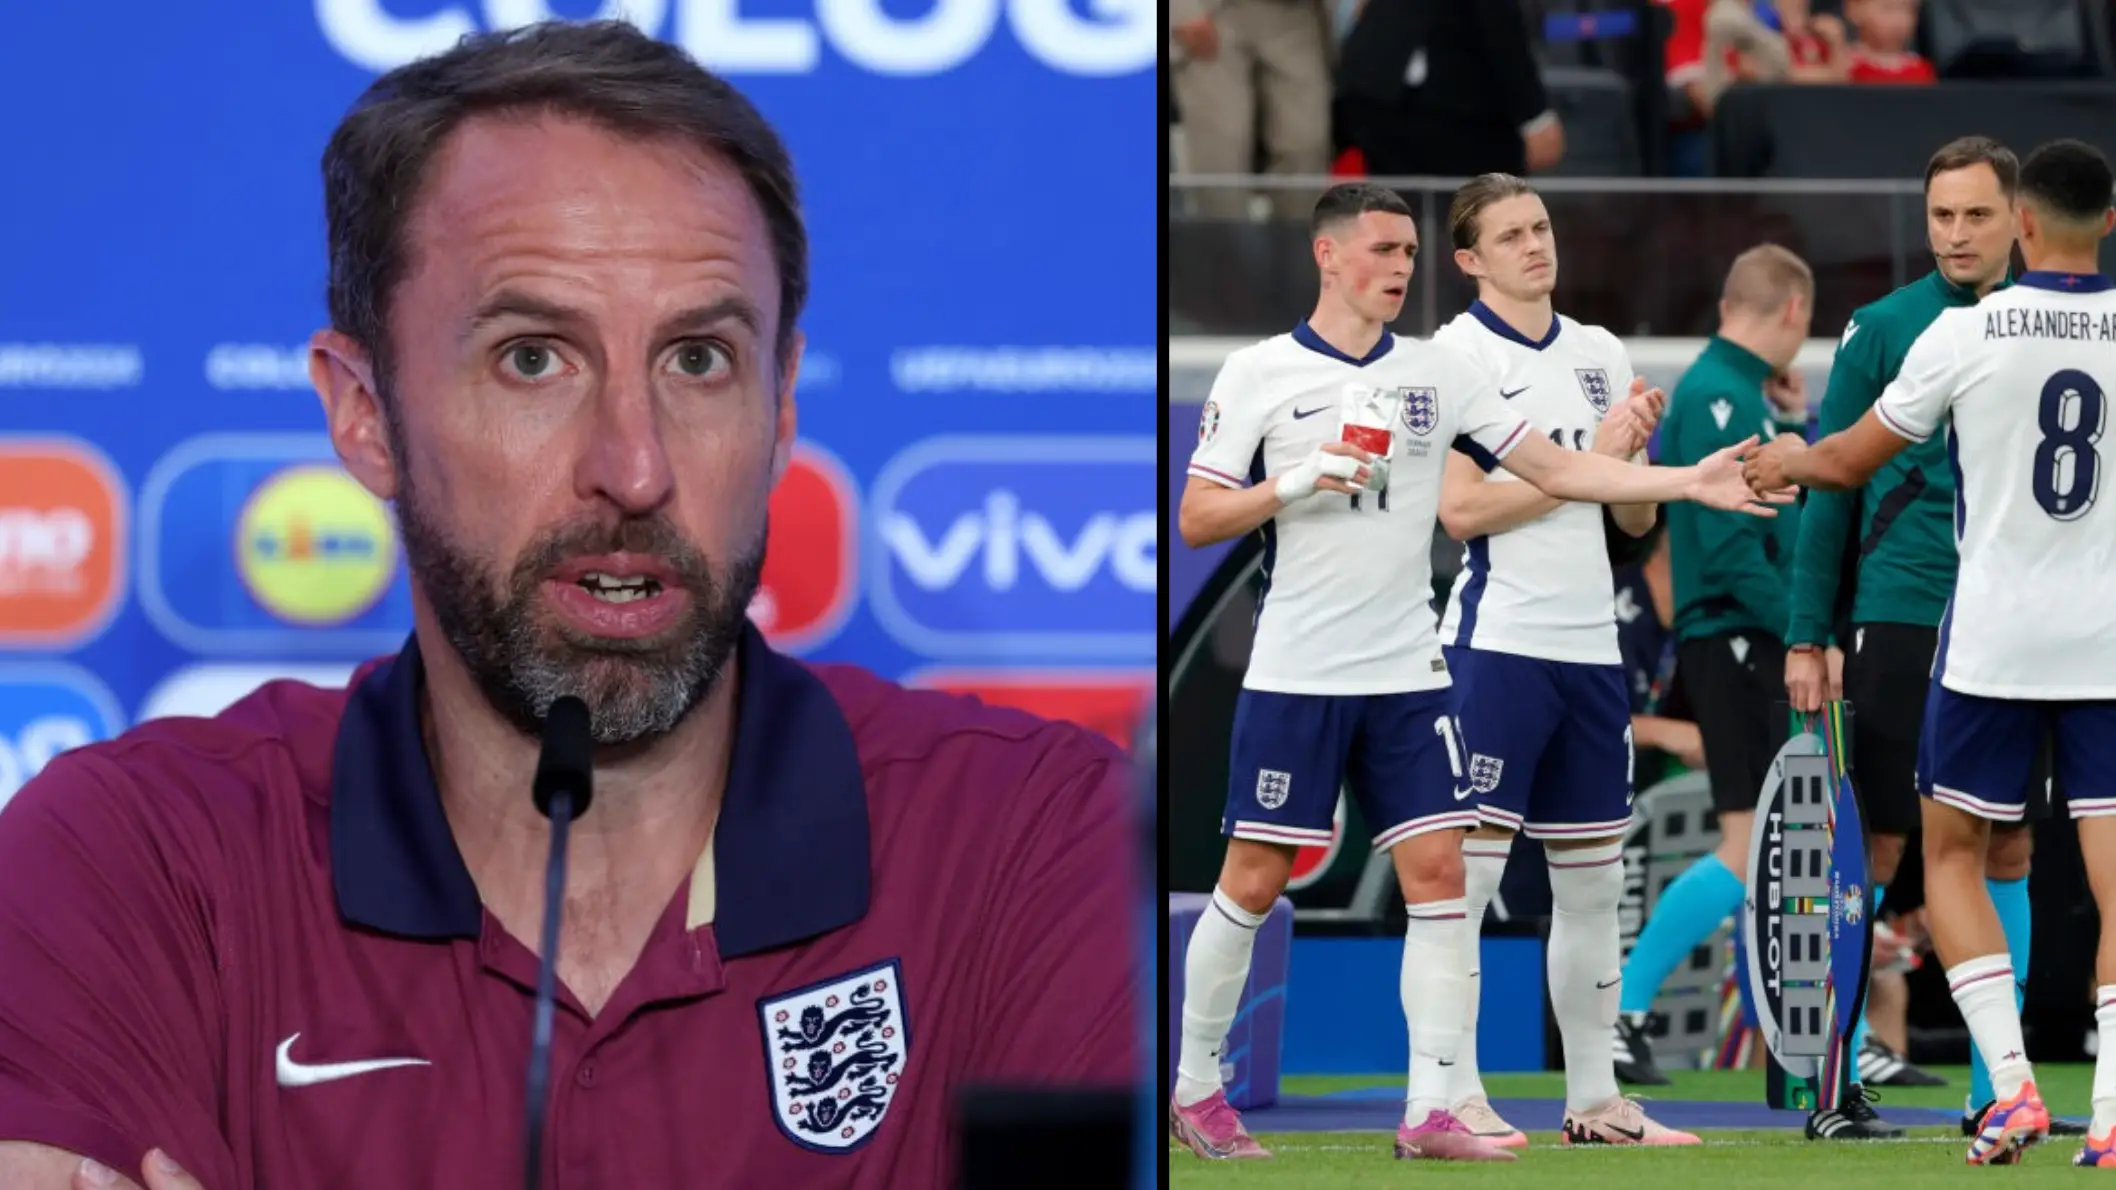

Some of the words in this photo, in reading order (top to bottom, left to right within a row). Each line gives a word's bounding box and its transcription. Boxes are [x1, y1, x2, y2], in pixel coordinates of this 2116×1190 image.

[315, 0, 1157, 77] CLOG
[2032, 368, 2107, 522] 8
[1767, 812, 1783, 998] HUBLOT
